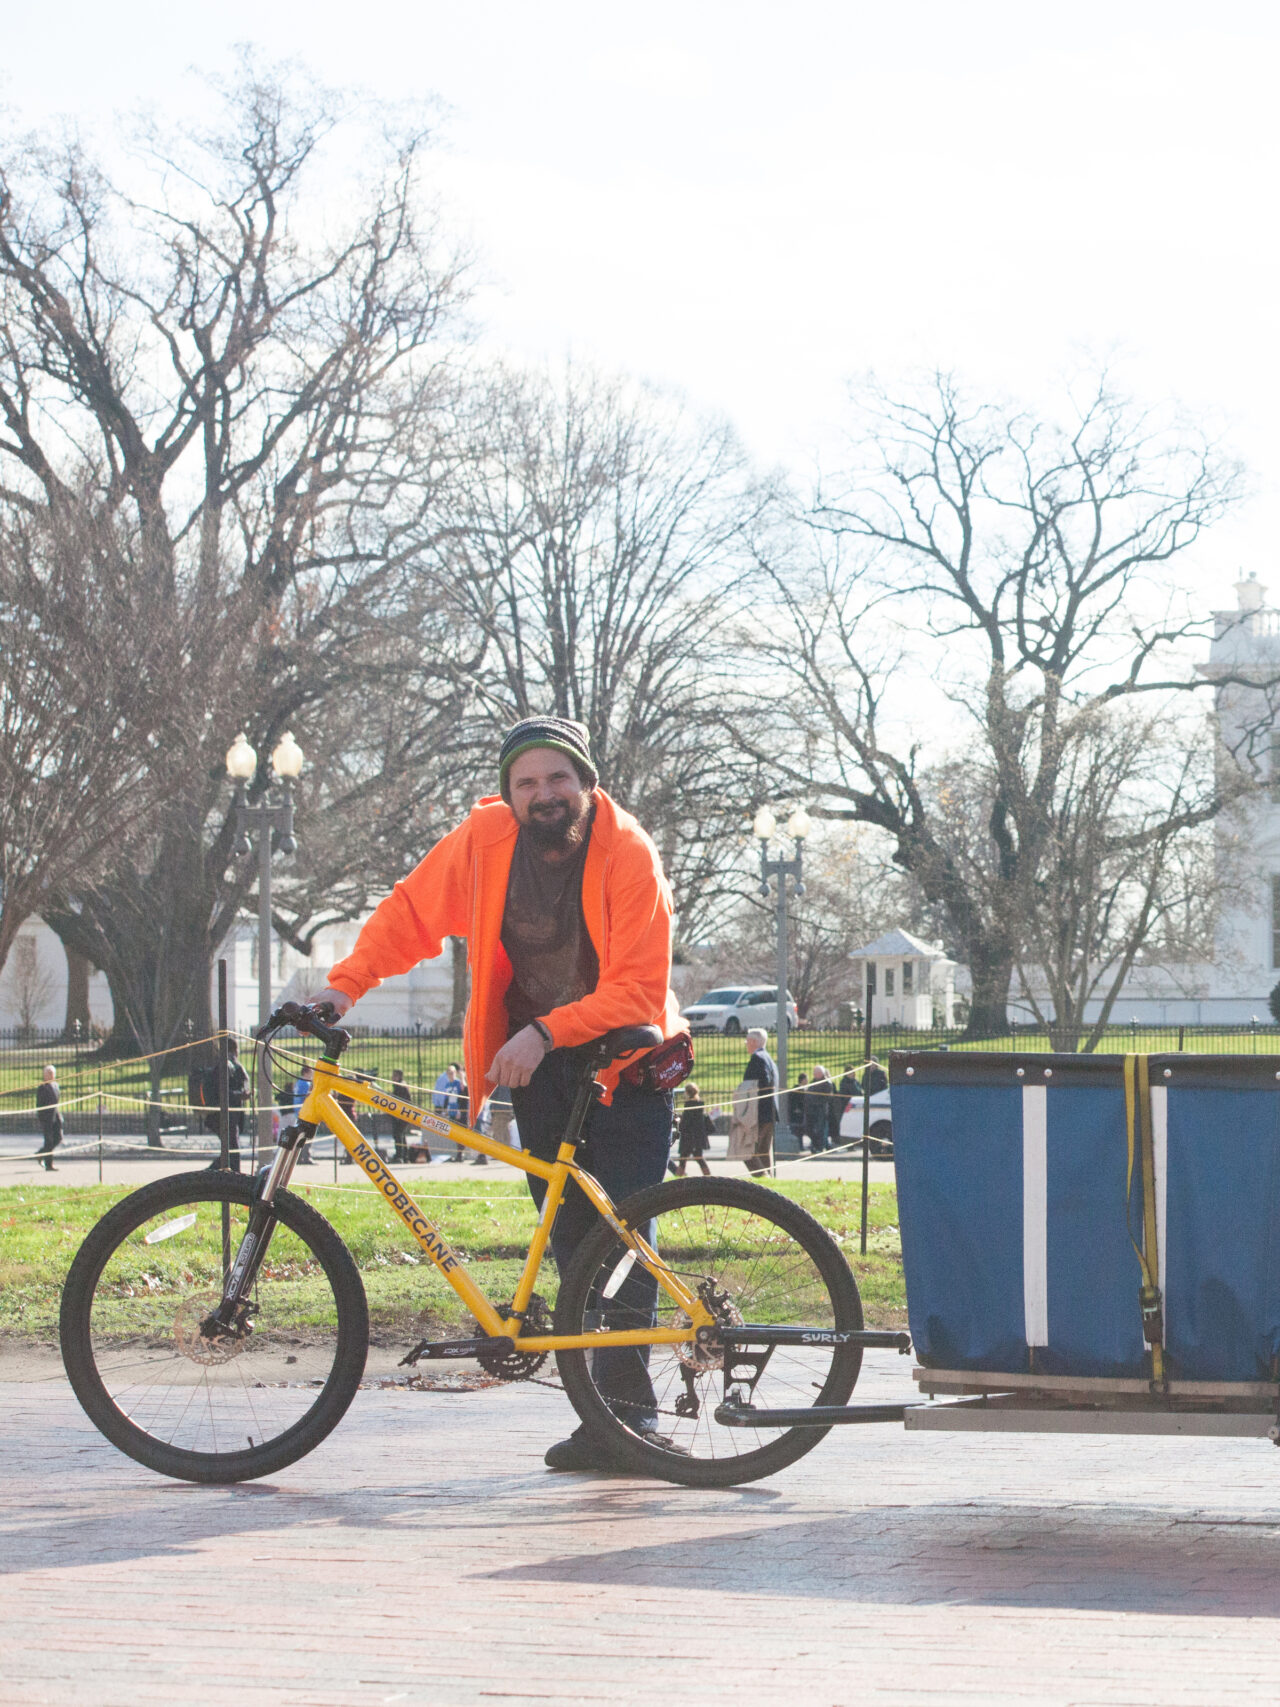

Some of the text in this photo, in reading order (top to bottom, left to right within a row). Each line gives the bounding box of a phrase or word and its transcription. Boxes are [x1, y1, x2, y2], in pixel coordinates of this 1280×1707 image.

[371, 1095, 421, 1121] 400 HT
[435, 1120, 450, 1132] PHL
[353, 1142, 459, 1273] MOTOBECANE
[801, 1333, 850, 1343] SURLY
